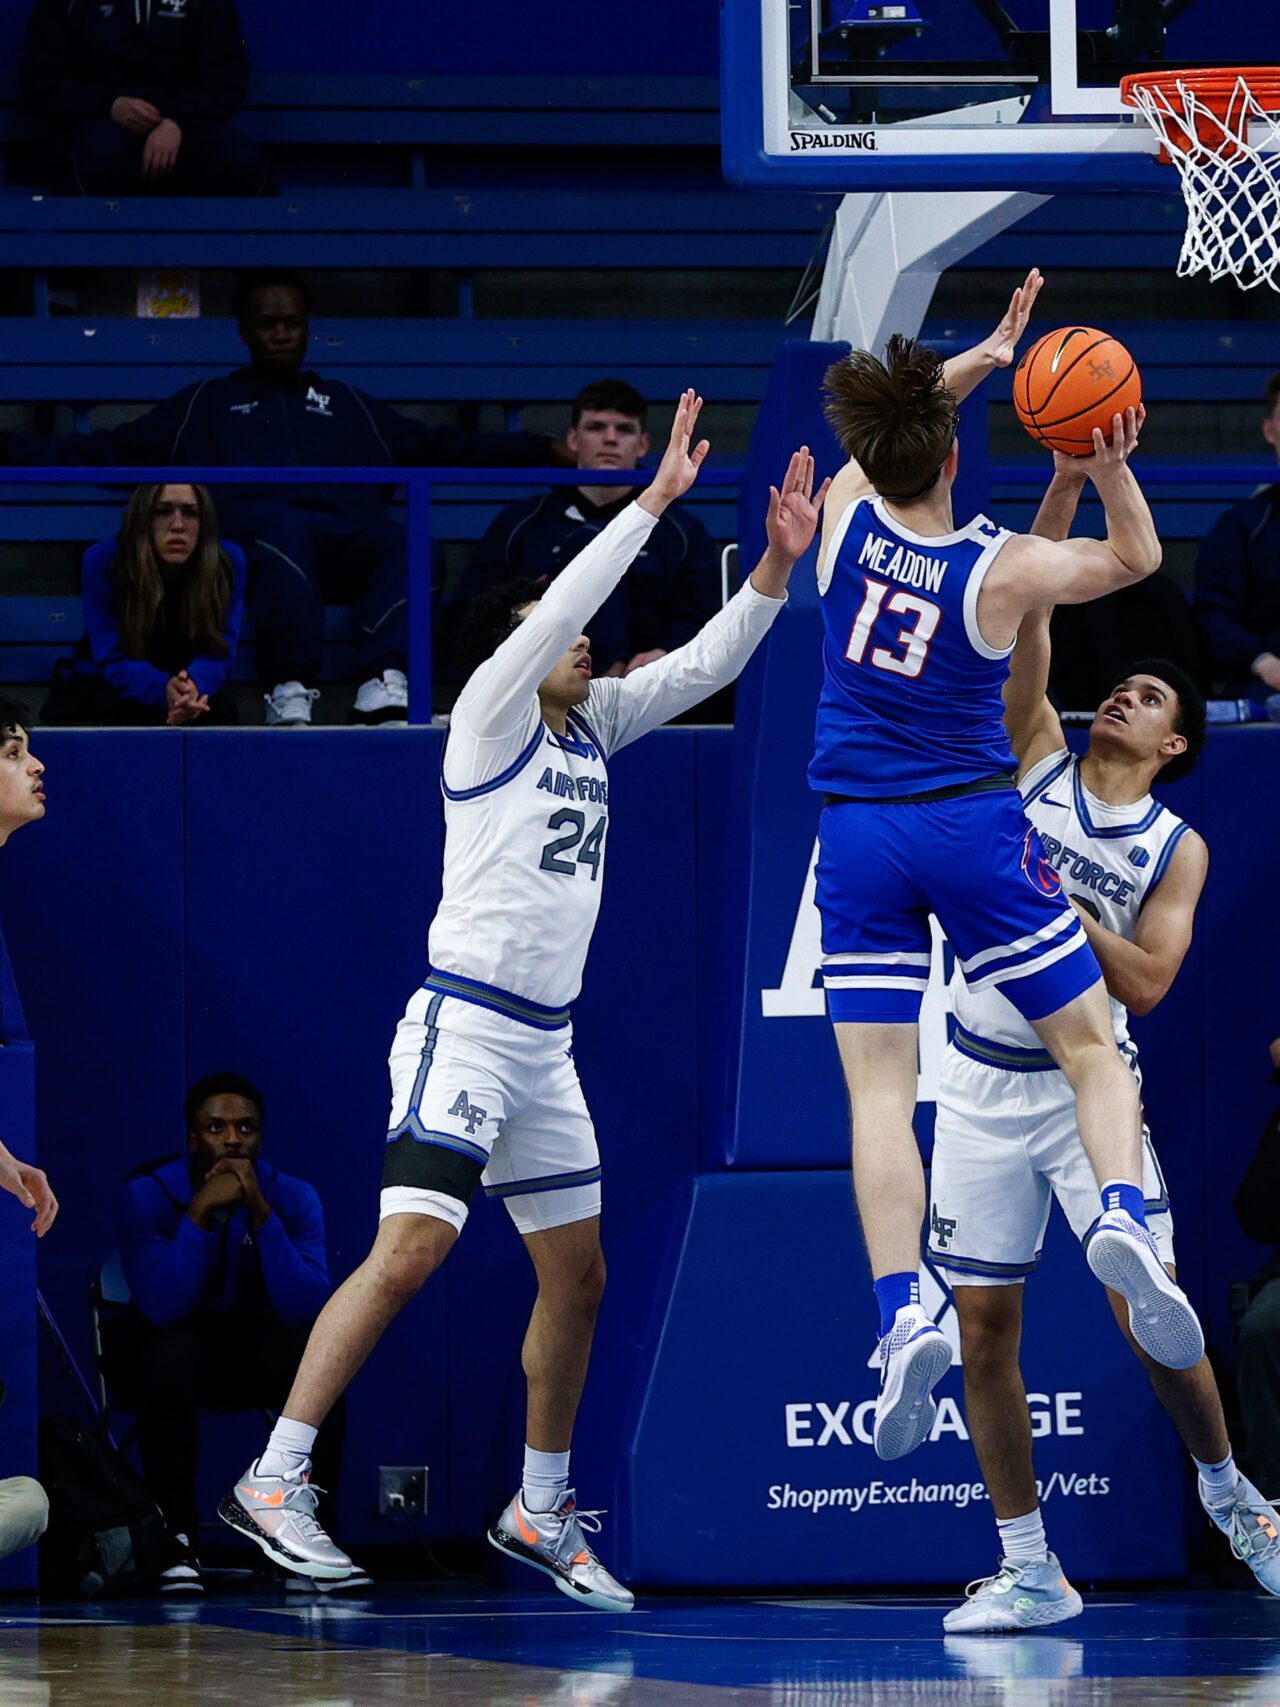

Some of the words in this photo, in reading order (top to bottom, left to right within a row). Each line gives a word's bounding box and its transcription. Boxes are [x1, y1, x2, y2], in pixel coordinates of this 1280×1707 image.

[790, 131, 876, 151] SPALDING
[857, 532, 948, 594] MEADOW
[844, 576, 943, 679] 13
[539, 807, 606, 881] 24
[448, 1089, 487, 1135] AF
[785, 1392, 1085, 1447] EXCAGE
